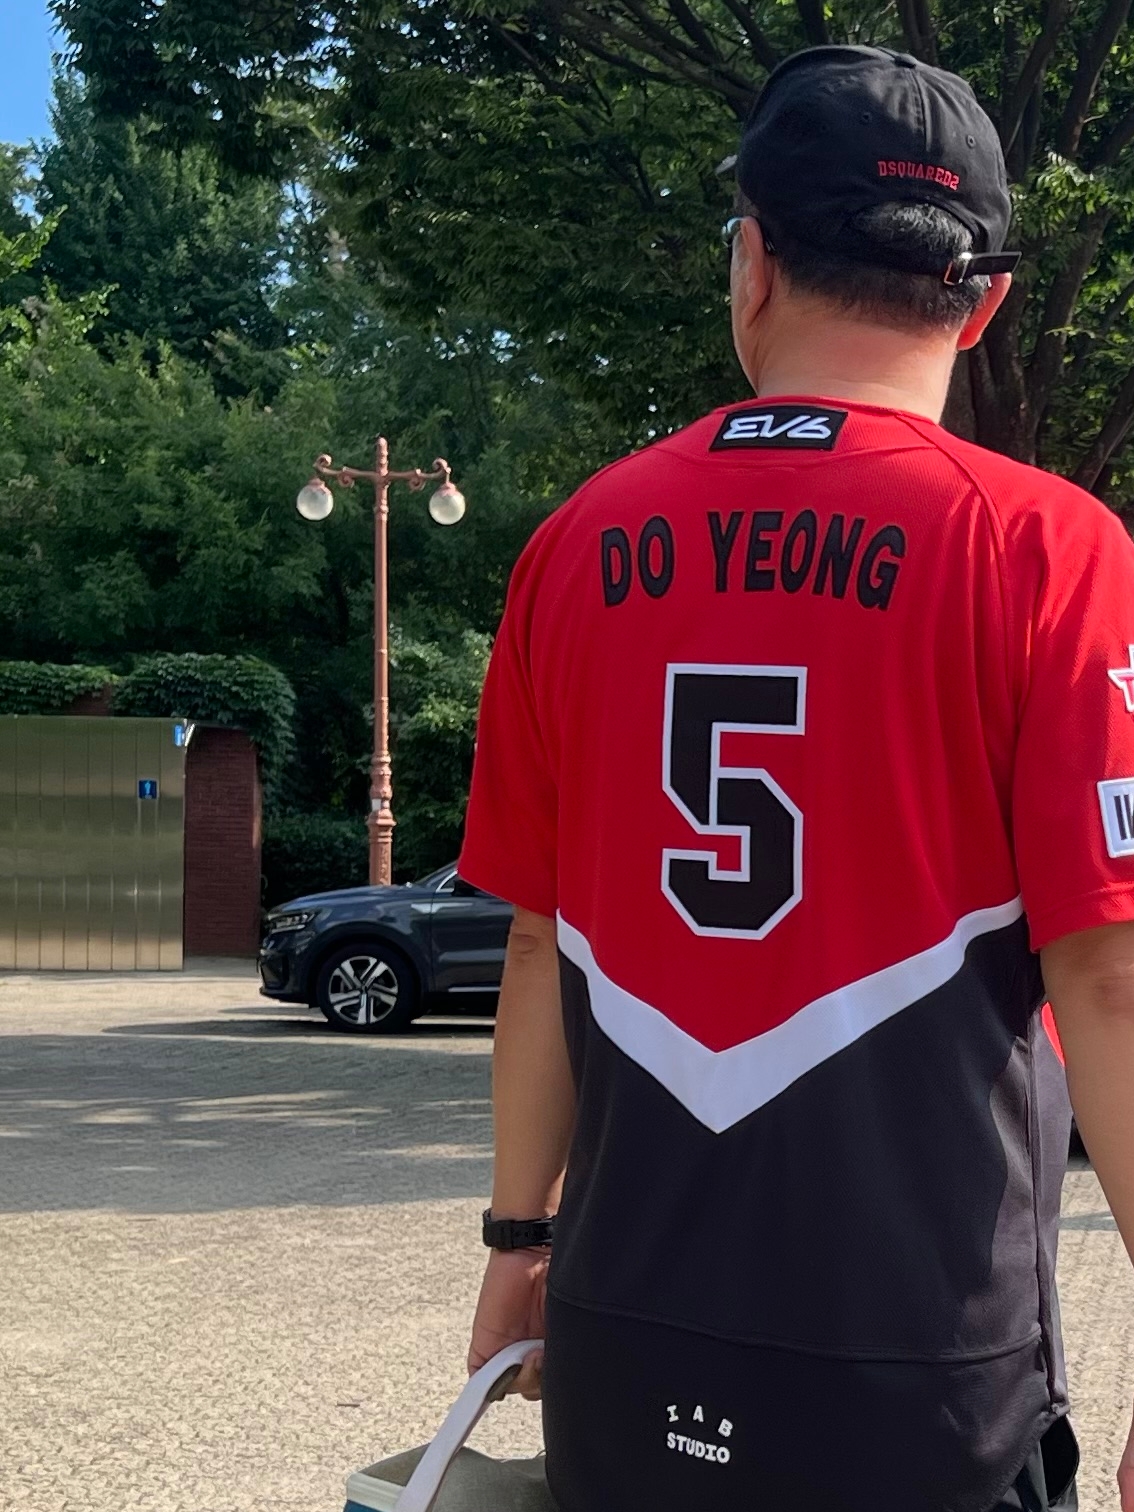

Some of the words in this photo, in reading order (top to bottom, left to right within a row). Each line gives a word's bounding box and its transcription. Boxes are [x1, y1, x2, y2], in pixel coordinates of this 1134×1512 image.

[877, 160, 961, 190] DSQUARED2
[722, 414, 832, 440] EV6
[602, 515, 675, 607] DO
[707, 509, 906, 611] YEONG
[661, 662, 808, 941] 5
[667, 1432, 730, 1463] STUDIO
